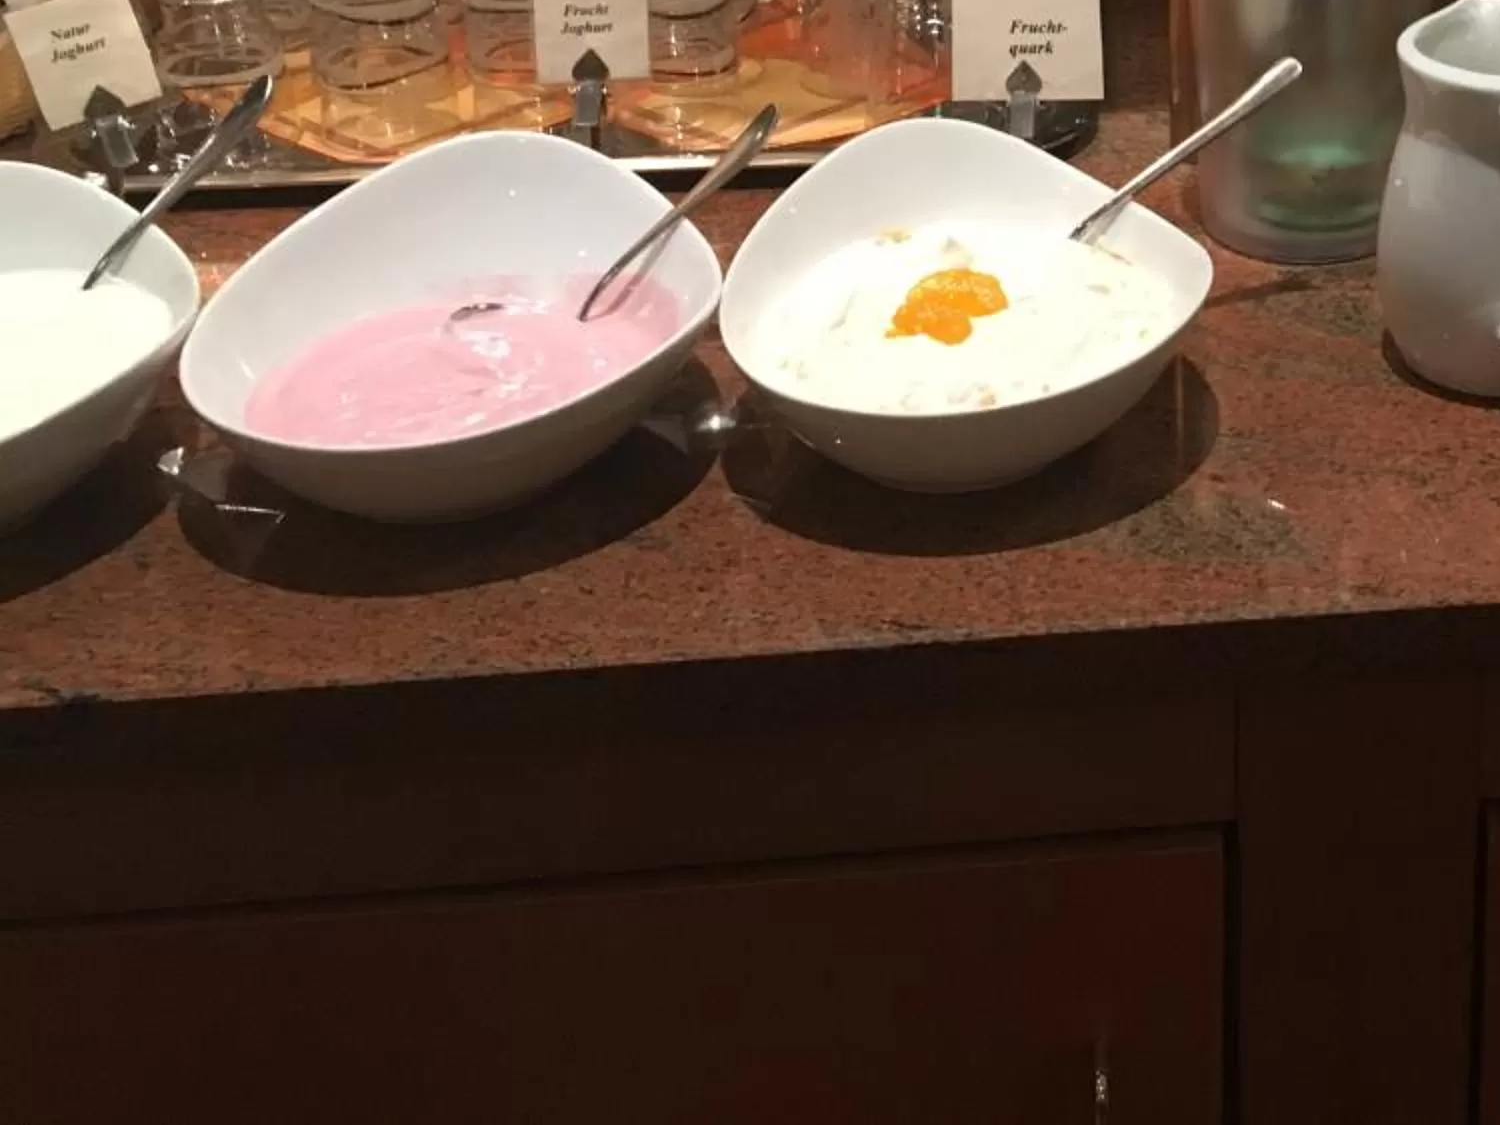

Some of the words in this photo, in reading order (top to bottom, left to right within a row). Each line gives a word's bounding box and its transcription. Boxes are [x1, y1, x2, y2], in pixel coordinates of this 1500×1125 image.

[563, 3, 609, 17] Frucht
[50, 23, 91, 41] Natur
[561, 21, 613, 36] Joghurt
[1010, 19, 1068, 35] Frucht-
[52, 36, 107, 63] Joghurt
[1009, 40, 1053, 59] quark
